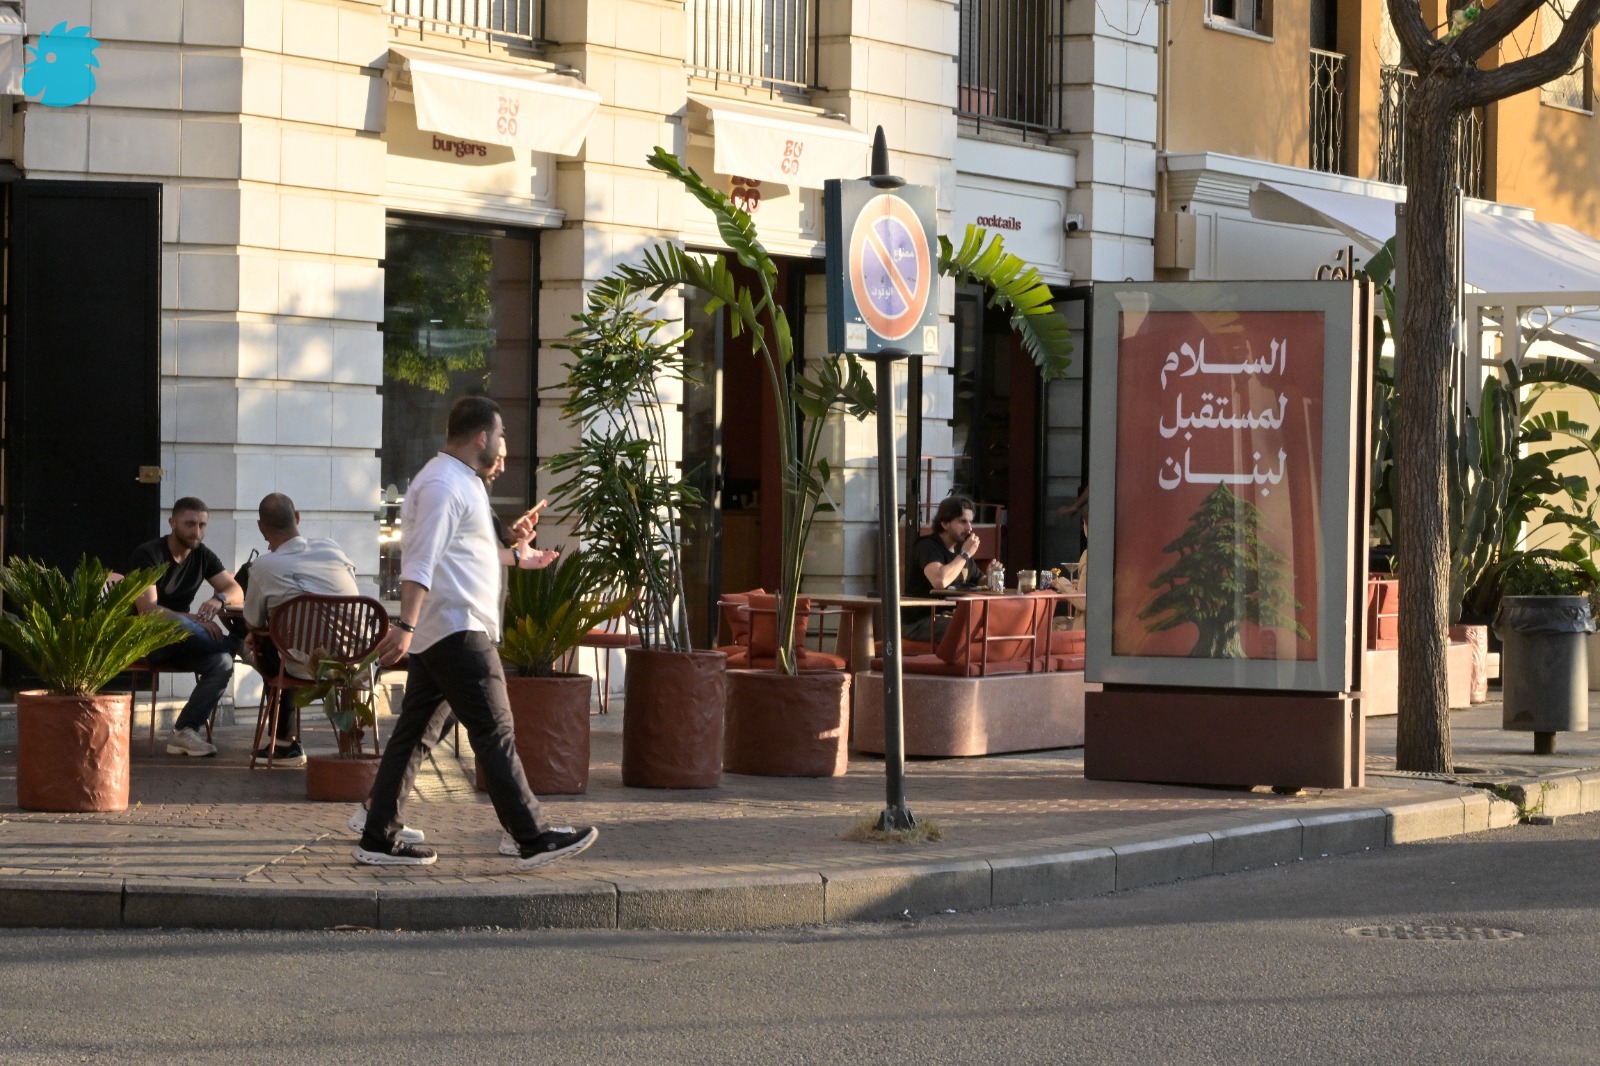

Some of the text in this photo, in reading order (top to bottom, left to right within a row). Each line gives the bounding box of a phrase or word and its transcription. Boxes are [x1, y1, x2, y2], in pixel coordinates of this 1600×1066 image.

[432, 134, 487, 158] burgers
[976, 214, 1022, 231] cocktails
[893, 247, 915, 263] ممنوع
[871, 284, 894, 300] الوقوف
[1160, 337, 1288, 390] السلام
[1159, 392, 1289, 441] لمستقبل
[1158, 446, 1288, 497] لبنان
